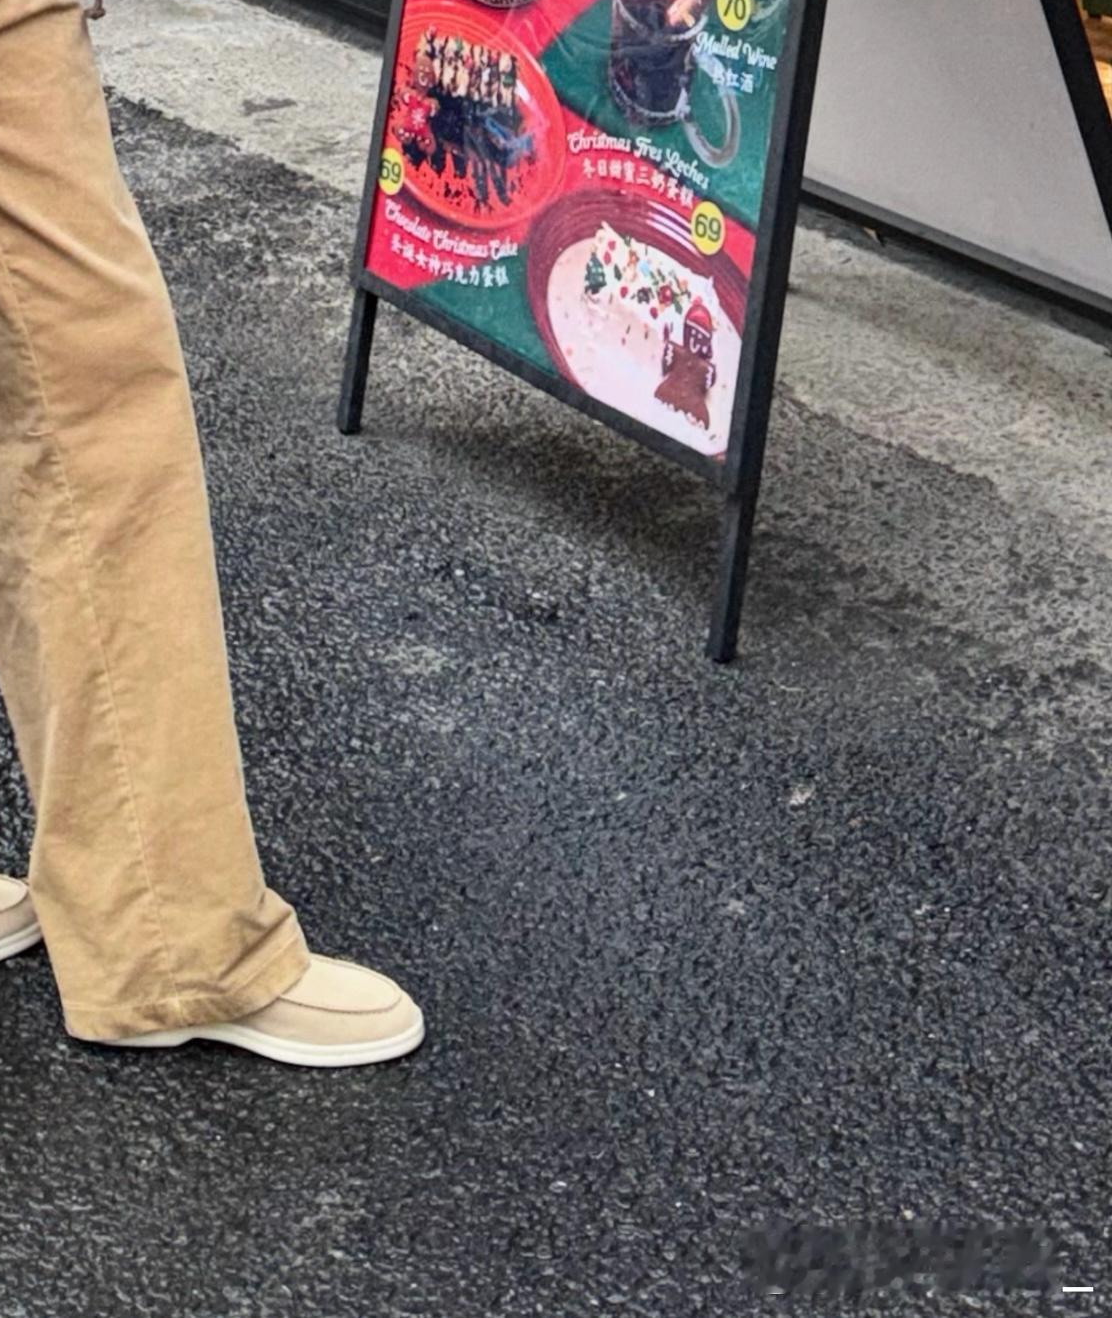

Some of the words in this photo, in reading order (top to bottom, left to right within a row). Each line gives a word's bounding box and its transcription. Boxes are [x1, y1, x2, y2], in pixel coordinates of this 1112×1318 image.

[692, 31, 742, 60] Mulled
[742, 43, 777, 70] Wine
[380, 158, 402, 184] 69
[567, 128, 632, 153] Christmas
[633, 135, 663, 161] Tres
[662, 148, 710, 189] Leches
[694, 213, 722, 243] 69
[433, 229, 488, 258] Christmas
[488, 237, 519, 260] Cake
